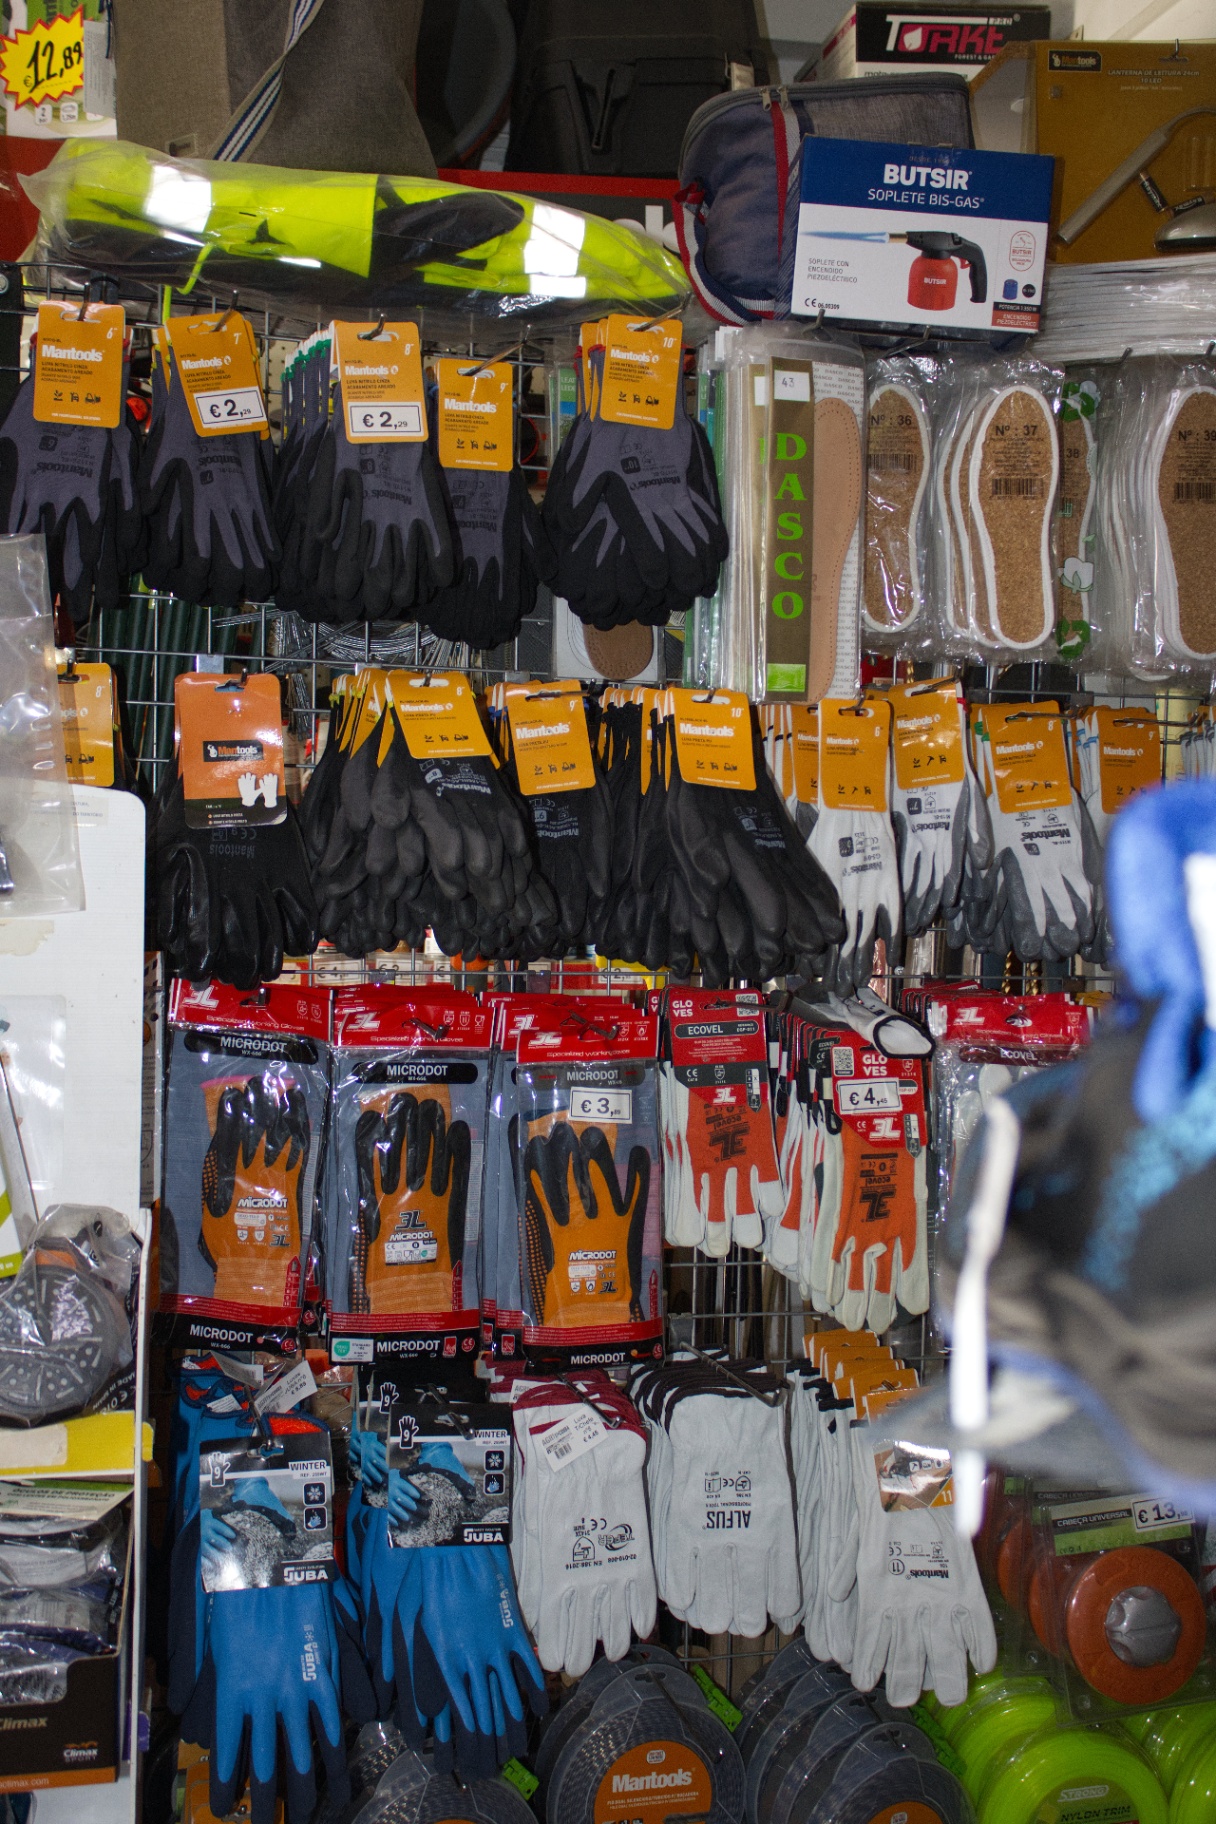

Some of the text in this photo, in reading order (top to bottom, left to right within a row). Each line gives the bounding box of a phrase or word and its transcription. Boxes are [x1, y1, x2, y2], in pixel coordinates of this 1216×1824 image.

[884, 163, 969, 191] BUTSIR
[868, 188, 981, 209] SOPLETE BIS-GAS
[808, 257, 850, 267] SOPLETE CON
[808, 265, 844, 275] ENCENDIDO
[923, 277, 947, 285] BUTSIR
[42, 344, 103, 362] Mantools
[610, 348, 650, 363] Mantools
[181, 355, 223, 371] Mantools
[344, 365, 389, 376] Mantools
[782, 377, 795, 389] 43
[209, 398, 252, 419] € 2,29
[444, 398, 497, 413] Mantools
[362, 410, 408, 431] € 2,29
[897, 415, 912, 426] 36
[1023, 425, 1039, 437] 37
[771, 432, 808, 620] DASCO
[400, 703, 444, 714] Mantools
[897, 715, 933, 730] Mantools
[515, 722, 570, 740] Mantools
[679, 722, 734, 738] Mantools
[826, 736, 853, 745] Mantools
[218, 744, 258, 755] Mantools
[995, 743, 1035, 756] Mantools
[1103, 746, 1136, 757] Mantools
[1023, 828, 1071, 844] Mantools
[209, 844, 255, 858] Mantools
[672, 999, 693, 1009] GLO
[673, 1008, 693, 1018] VES
[687, 1024, 724, 1036] ECOVEL
[220, 1036, 288, 1053] MICRODOT
[370, 1035, 464, 1044] Specialized Gloves
[546, 1051, 584, 1059] Specialized
[862, 1054, 888, 1065] GLO
[386, 1064, 449, 1077] MICRODOT
[566, 1069, 620, 1082] MICRODOT
[686, 1068, 699, 1078] CE
[862, 1066, 888, 1077] VES
[849, 1087, 889, 1107] € 4,45
[581, 1099, 592, 1114] €
[856, 1120, 867, 1130] CE
[869, 1117, 901, 1139] 3L
[865, 1176, 891, 1187] ecovel
[237, 1197, 288, 1209] MICRODOT
[395, 1210, 428, 1231] 3L
[389, 1231, 434, 1241] MICRODOT
[568, 1249, 618, 1262] MICRODOT
[189, 1324, 254, 1343] MICRODOT
[376, 1340, 441, 1353] MICRODOT
[570, 1352, 626, 1366] MICRODOT
[384, 1395, 391, 1407] 9
[403, 1429, 410, 1441] 9
[474, 1429, 507, 1439] WINTER
[290, 1460, 326, 1471] WINTER
[214, 1467, 221, 1479] 9
[722, 1477, 735, 1489] CE
[941, 1489, 953, 1503] 11
[706, 1510, 752, 1530] ALFUS
[1057, 1510, 1131, 1528] CABEÇA UNIVERSAL
[1138, 1509, 1149, 1524] €
[592, 1518, 611, 1532] CE
[463, 1527, 505, 1543] JUBA
[888, 1545, 902, 1557] CE
[892, 1562, 902, 1573] 11
[283, 1566, 329, 1583] JUBA
[910, 1569, 950, 1581] Mantools
[302, 1643, 317, 1682] JUBA
[63, 1747, 98, 1759] Climax
[612, 1768, 693, 1794] Mantools
[1060, 1786, 1107, 1800] STRONG
[1060, 1805, 1131, 1823] NYLON TRIM
